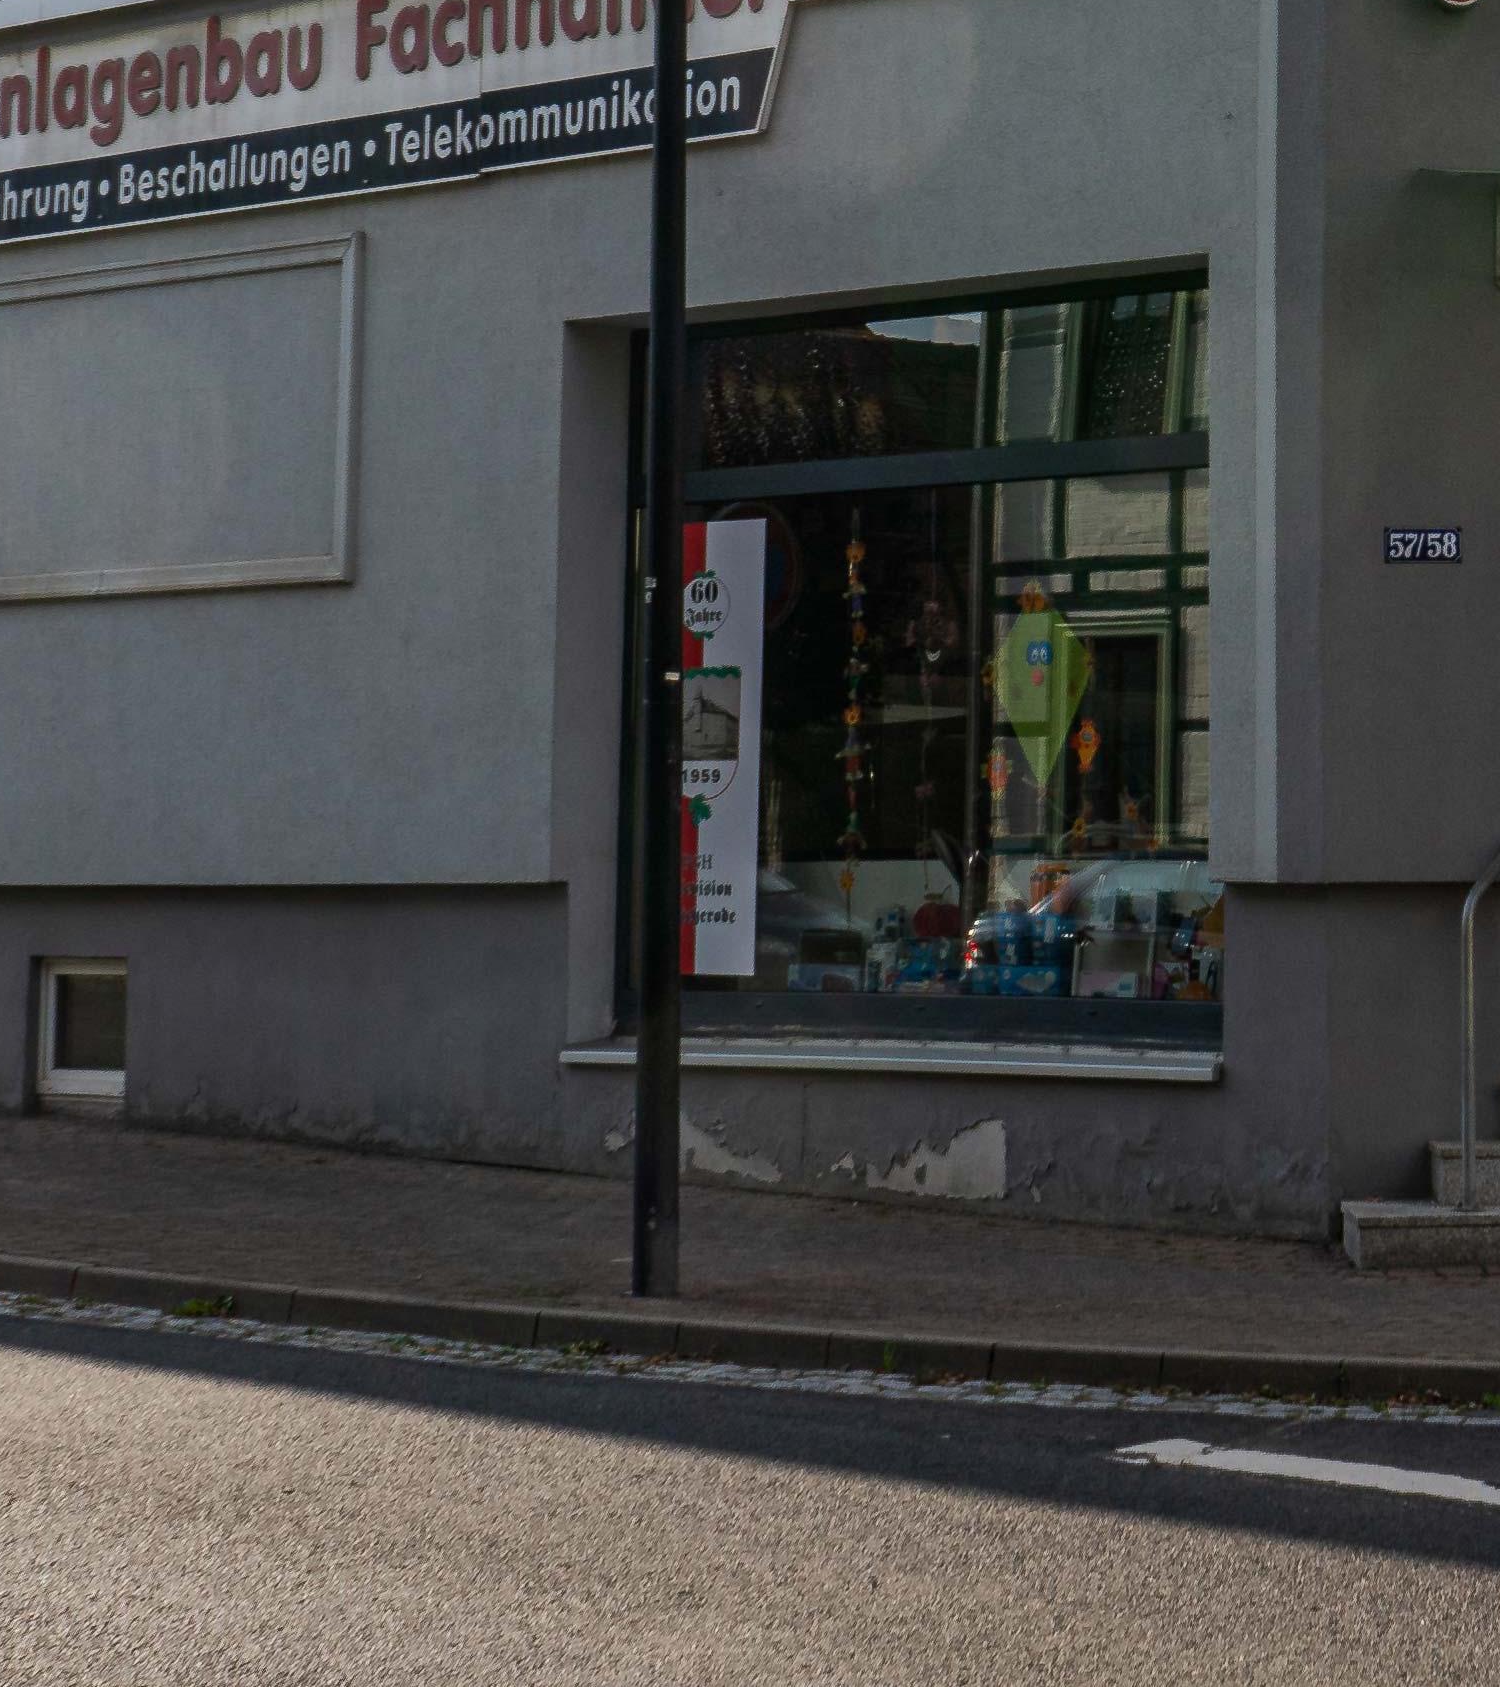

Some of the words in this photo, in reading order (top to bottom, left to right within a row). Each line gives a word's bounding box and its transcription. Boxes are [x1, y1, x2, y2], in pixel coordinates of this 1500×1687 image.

[117, 137, 351, 207] Beschallungen
[385, 69, 741, 167] Telekommunikaion
[1389, 532, 1457, 558] 57/58
[691, 580, 719, 603] 60
[682, 768, 721, 784] 1959
